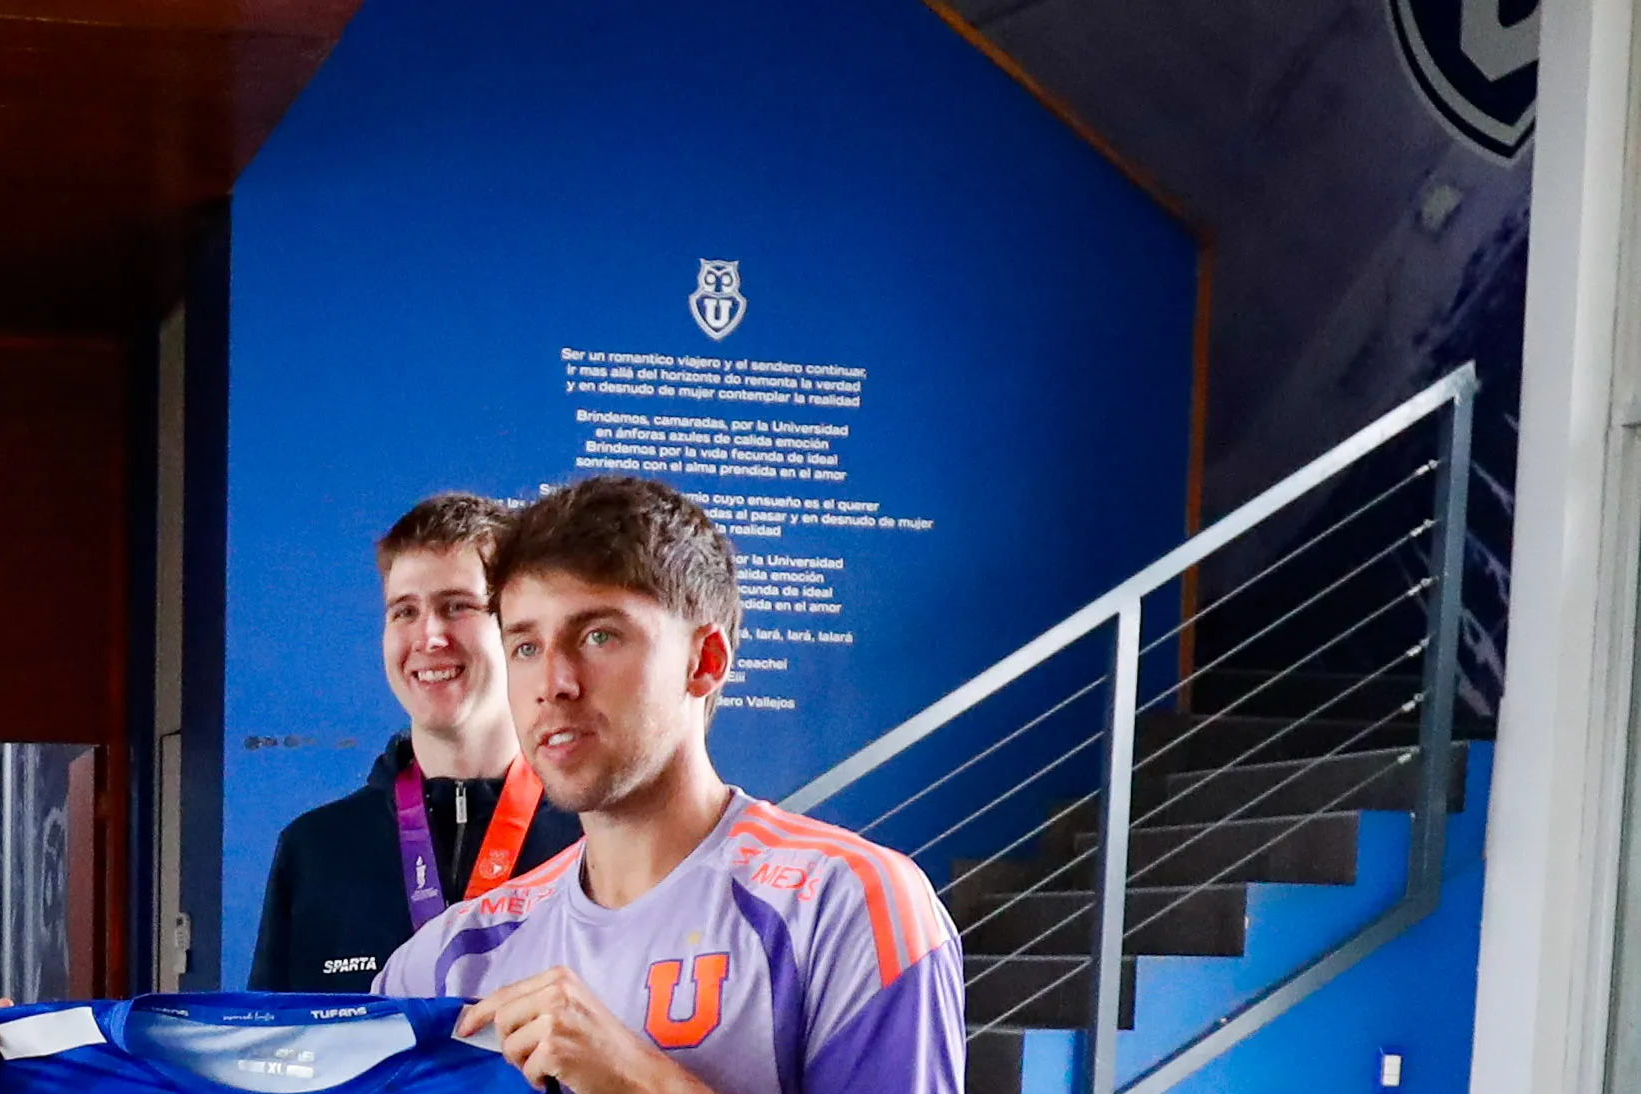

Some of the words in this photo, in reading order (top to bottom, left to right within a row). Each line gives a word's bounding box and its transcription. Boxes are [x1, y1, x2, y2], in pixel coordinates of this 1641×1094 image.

[561, 348, 586, 361] Ser
[588, 352, 605, 362] un
[678, 355, 721, 369] viajero
[724, 360, 732, 371] y
[735, 359, 748, 370] el
[751, 361, 803, 374] sendero
[637, 368, 658, 380] del
[661, 370, 721, 384] horizonte
[745, 376, 798, 389] remonta
[801, 378, 813, 389] la
[816, 380, 861, 392] verdad
[566, 381, 575, 392] y
[579, 382, 595, 391] en
[598, 381, 655, 395] desnudo
[658, 385, 676, 396] de
[679, 386, 715, 399] mujer
[718, 389, 791, 404] contemplar
[794, 392, 806, 404] la
[808, 394, 861, 407] realidad
[595, 428, 612, 437] en
[669, 432, 711, 443] azules
[713, 433, 731, 444] de
[731, 420, 754, 431] por
[757, 420, 769, 431] la
[772, 421, 849, 436] Universidad
[585, 441, 657, 455] Brindemos
[659, 446, 682, 457] por
[685, 446, 697, 457] la
[700, 447, 728, 460] vida
[730, 448, 784, 461] fecunda
[787, 452, 804, 463] de
[807, 453, 838, 465] ideal
[576, 456, 640, 470] sonriendo
[643, 460, 667, 470] con
[670, 461, 682, 471] el
[685, 462, 717, 474] alma
[719, 464, 777, 477] prendida
[779, 467, 796, 477] en
[799, 467, 811, 478] el
[813, 471, 847, 481] amor
[713, 494, 745, 506] cuyo
[804, 499, 820, 509] es
[822, 499, 835, 510] el
[837, 501, 880, 512] querer
[735, 509, 748, 520] al
[750, 511, 787, 522] pasar
[790, 514, 799, 525] y
[801, 514, 818, 524] en
[821, 513, 876, 526] desnudo
[878, 516, 896, 528] de
[898, 518, 934, 530] mujer
[729, 525, 782, 537] realidad
[751, 554, 764, 566] la
[767, 554, 844, 569] Universidad
[782, 586, 799, 597] de
[802, 586, 833, 598] ideal
[775, 602, 792, 612] en
[794, 601, 807, 612] el
[809, 604, 842, 614] amor
[747, 696, 796, 710] Vallejos
[323, 957, 377, 974] SPARTA
[644, 951, 730, 1050] U
